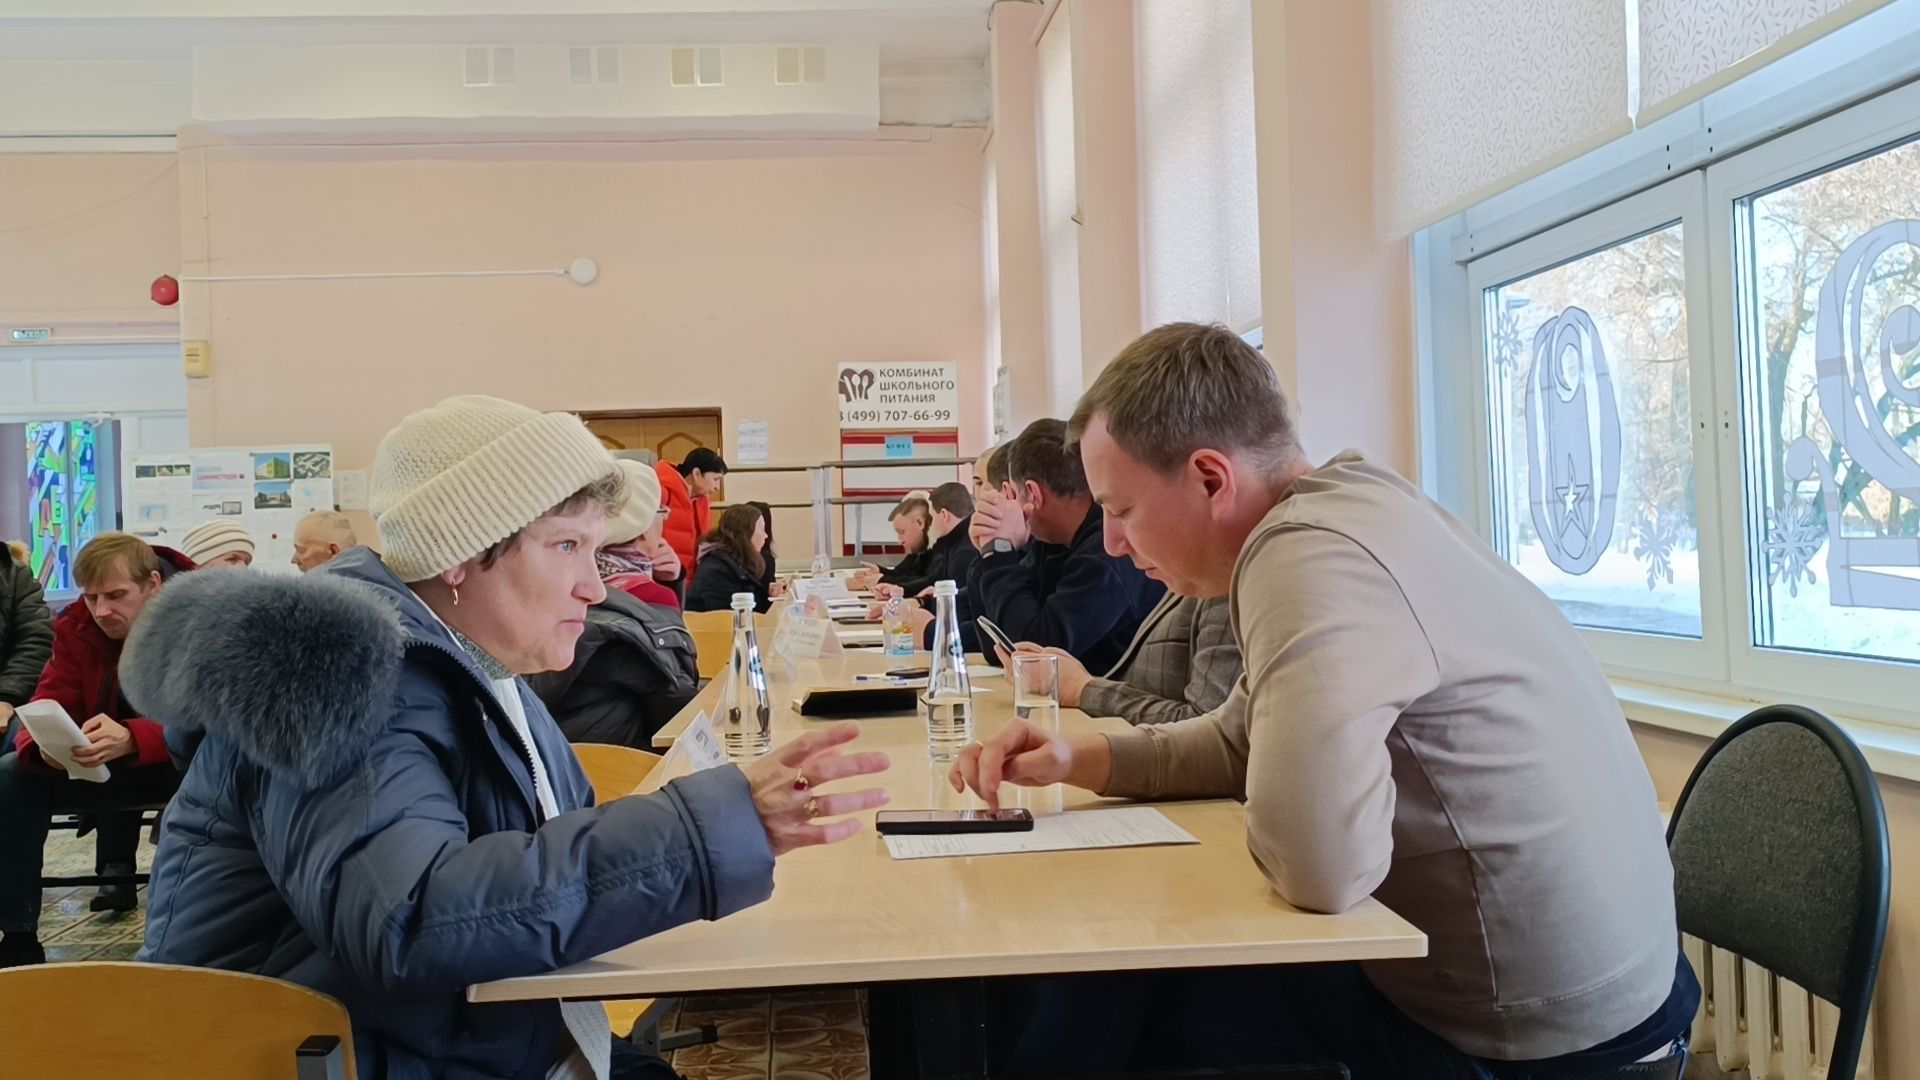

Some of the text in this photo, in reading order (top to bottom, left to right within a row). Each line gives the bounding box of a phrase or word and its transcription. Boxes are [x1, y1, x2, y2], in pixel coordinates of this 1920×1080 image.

[879, 368, 944, 378] КОМБИНАТ
[879, 381, 955, 391] ШКОЛЬНОГО
[880, 394, 936, 403] ПИТАНИЯ
[847, 410, 880, 422] (499)
[885, 410, 951, 421] 707-66-99
